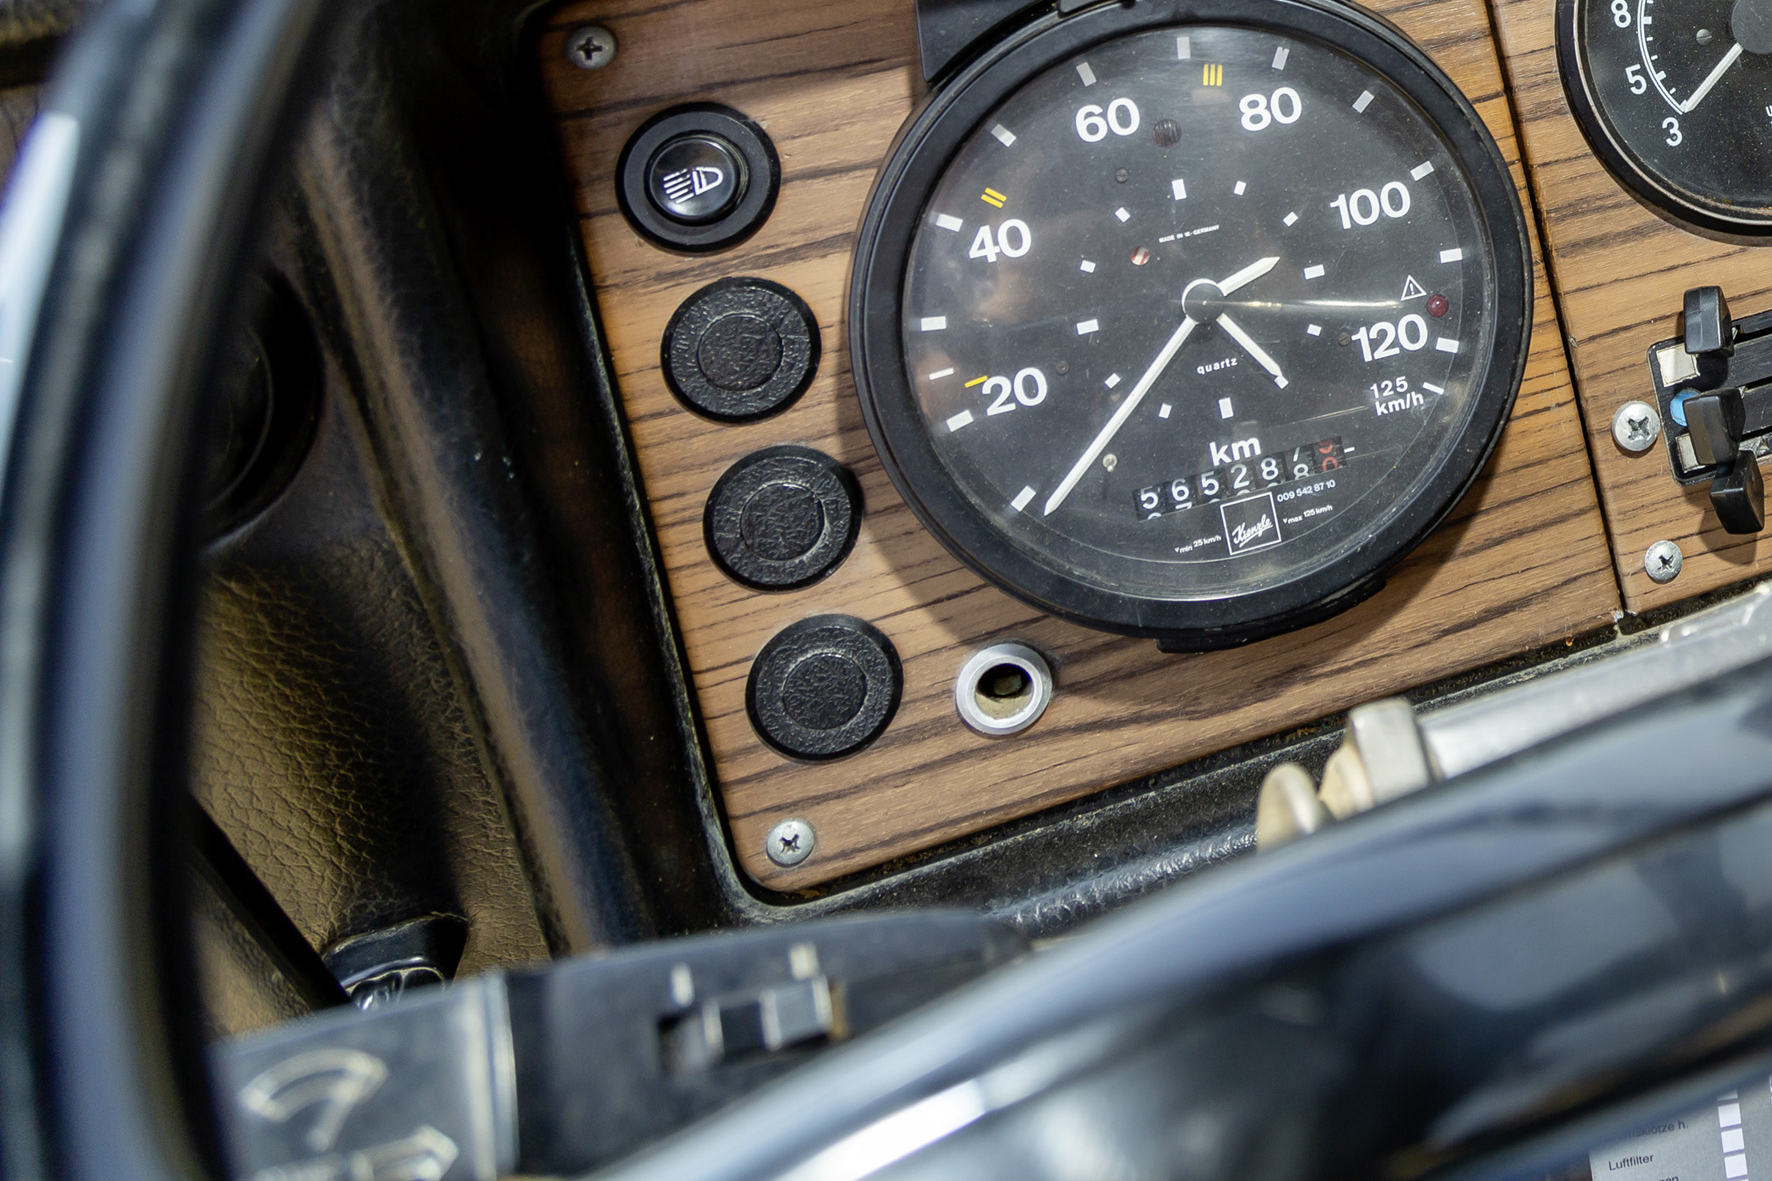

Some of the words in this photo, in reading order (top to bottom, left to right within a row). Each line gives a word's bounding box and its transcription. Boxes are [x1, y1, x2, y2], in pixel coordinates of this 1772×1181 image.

[1625, 63, 1648, 96] 5
[1074, 96, 1141, 144] 60
[1237, 86, 1303, 132] 80
[1662, 117, 1683, 147] 3
[1329, 181, 1412, 229] 100
[967, 218, 1032, 264] 40
[1351, 313, 1428, 362] 120
[1196, 357, 1238, 375] quartz
[980, 367, 1048, 416] 20
[1369, 376, 1409, 399] 125
[1374, 391, 1425, 416] km/h
[1209, 437, 1262, 467] km
[1276, 490, 1295, 503] 009
[1296, 486, 1314, 498] 542
[1313, 482, 1325, 493] 87
[1325, 479, 1336, 489] 10
[1315, 504, 1334, 515] km/h
[1203, 534, 1222, 545] km/h
[1232, 513, 1274, 546] Kienzle
[1608, 1153, 1654, 1171] Luftfilter
